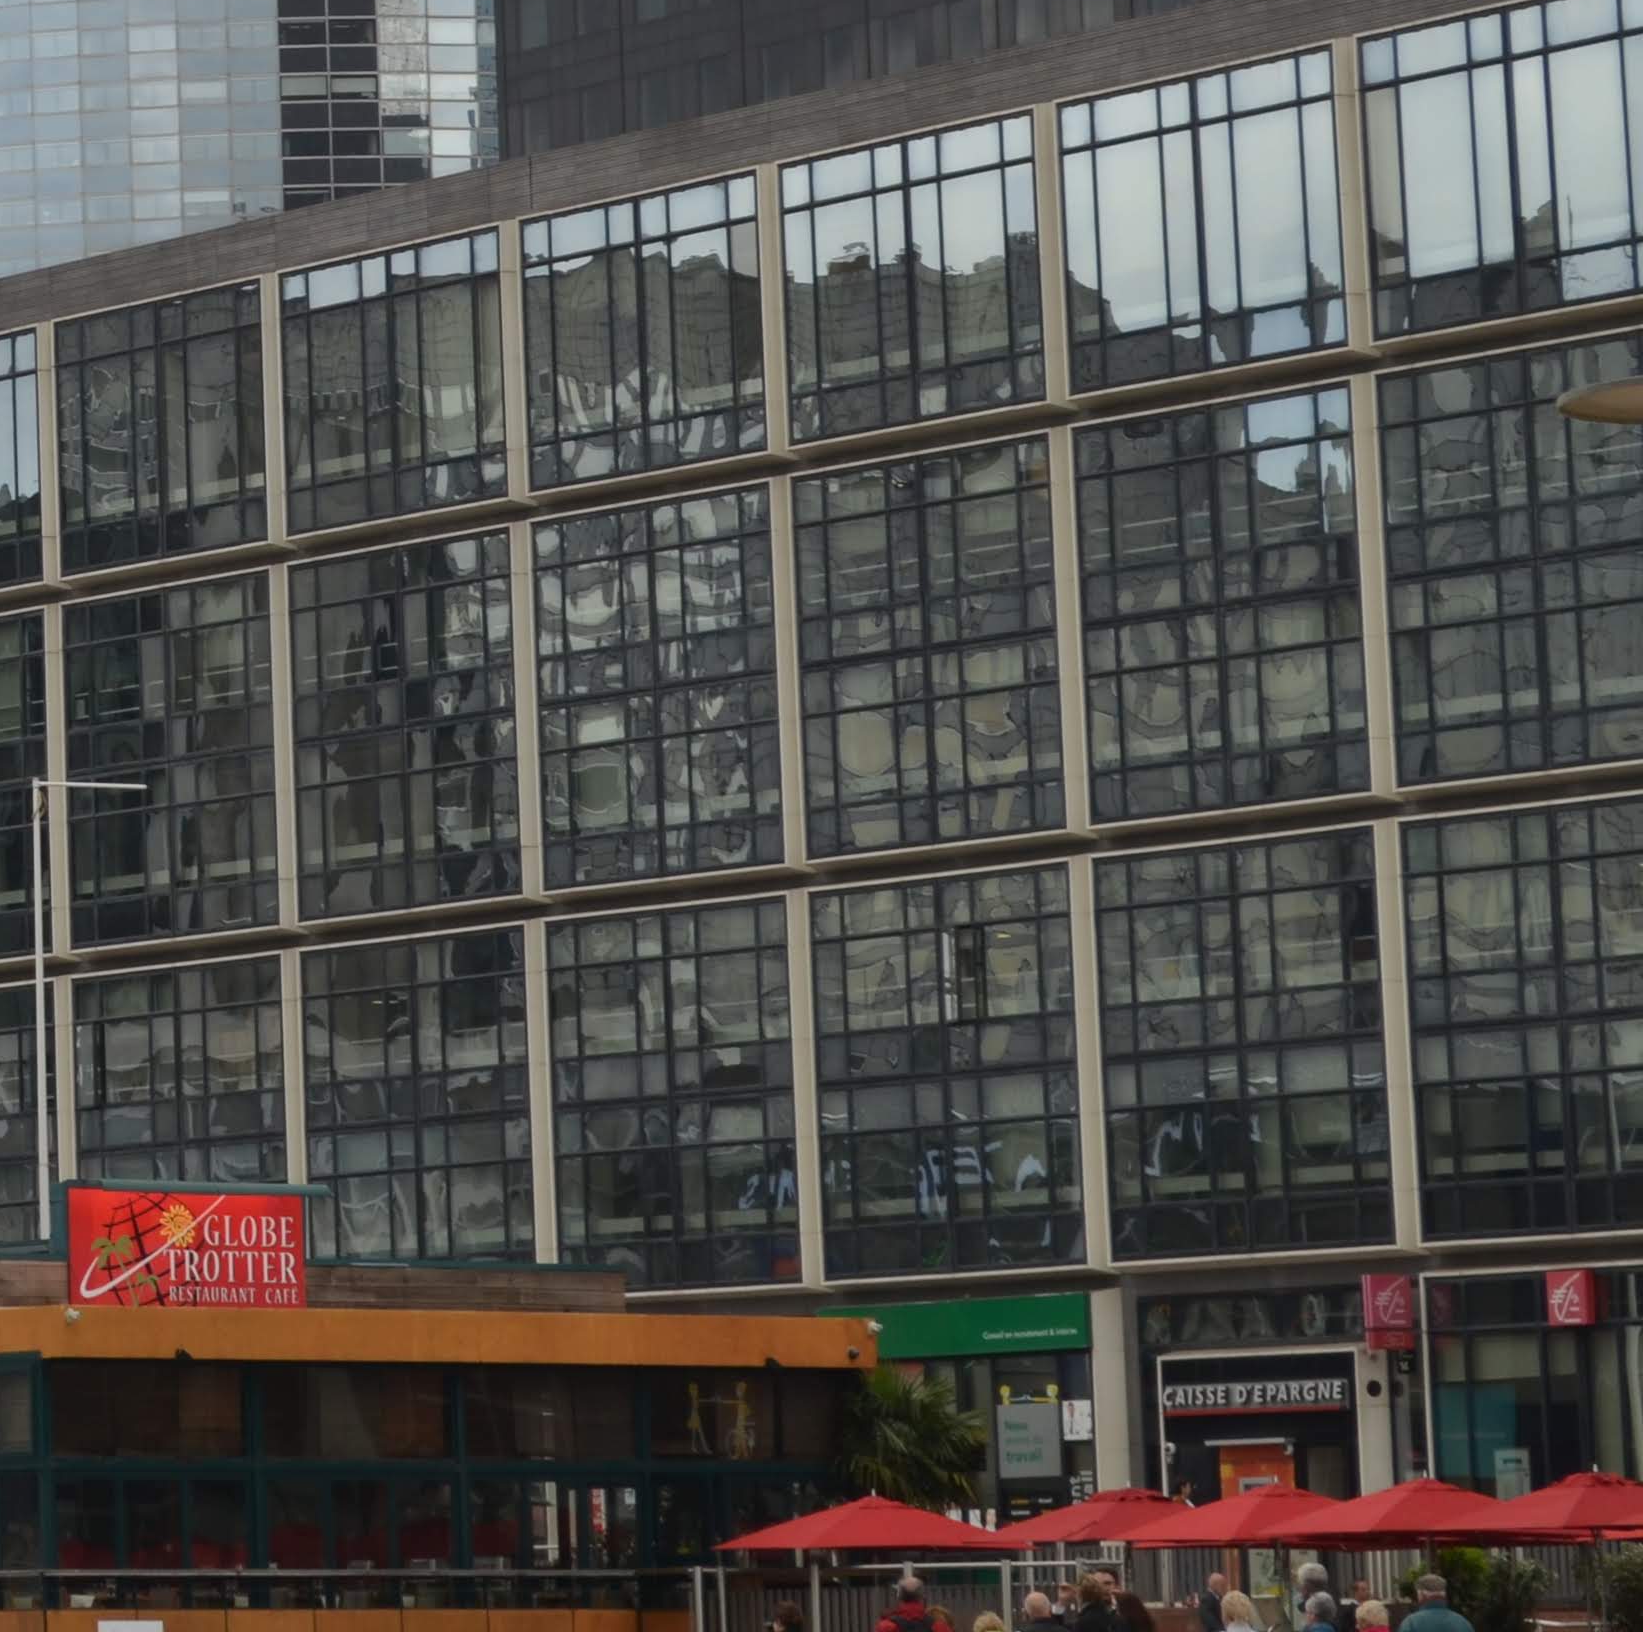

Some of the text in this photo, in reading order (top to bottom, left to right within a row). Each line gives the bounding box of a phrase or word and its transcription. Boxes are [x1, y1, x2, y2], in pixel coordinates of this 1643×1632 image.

[204, 1215, 295, 1248] GLOBE
[164, 1249, 297, 1284] TROTTER
[169, 1285, 256, 1303] RESTAURANT
[1163, 1380, 1343, 1406] CAISSE D'EPARGNE
